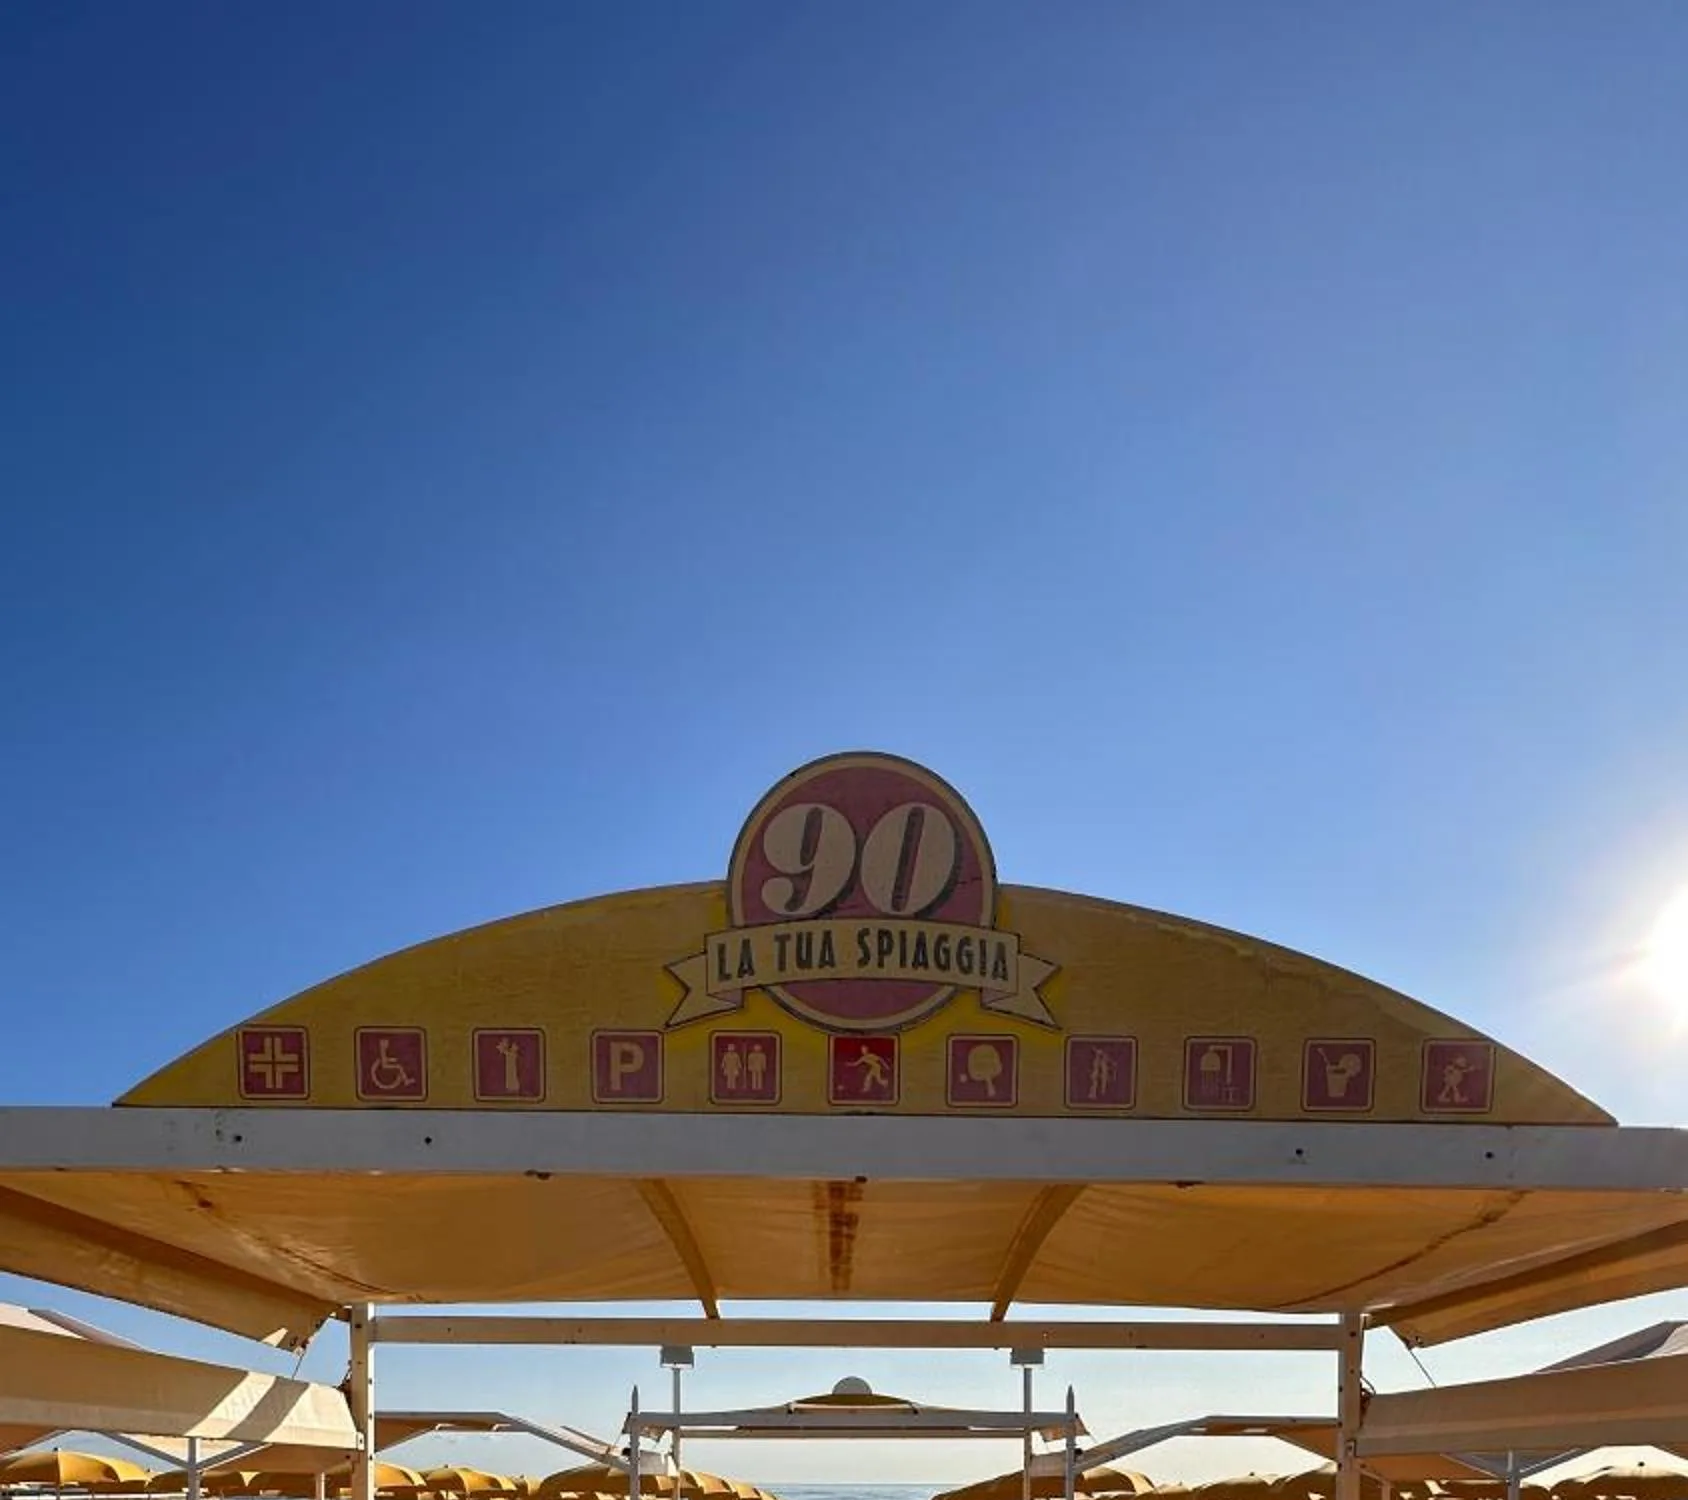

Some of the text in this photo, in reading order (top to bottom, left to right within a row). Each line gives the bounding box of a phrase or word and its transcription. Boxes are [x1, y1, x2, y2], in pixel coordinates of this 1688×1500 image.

[762, 803, 957, 916] 90
[716, 926, 1009, 982] LA TUA SPIAGGIA
[609, 1041, 645, 1092] P
